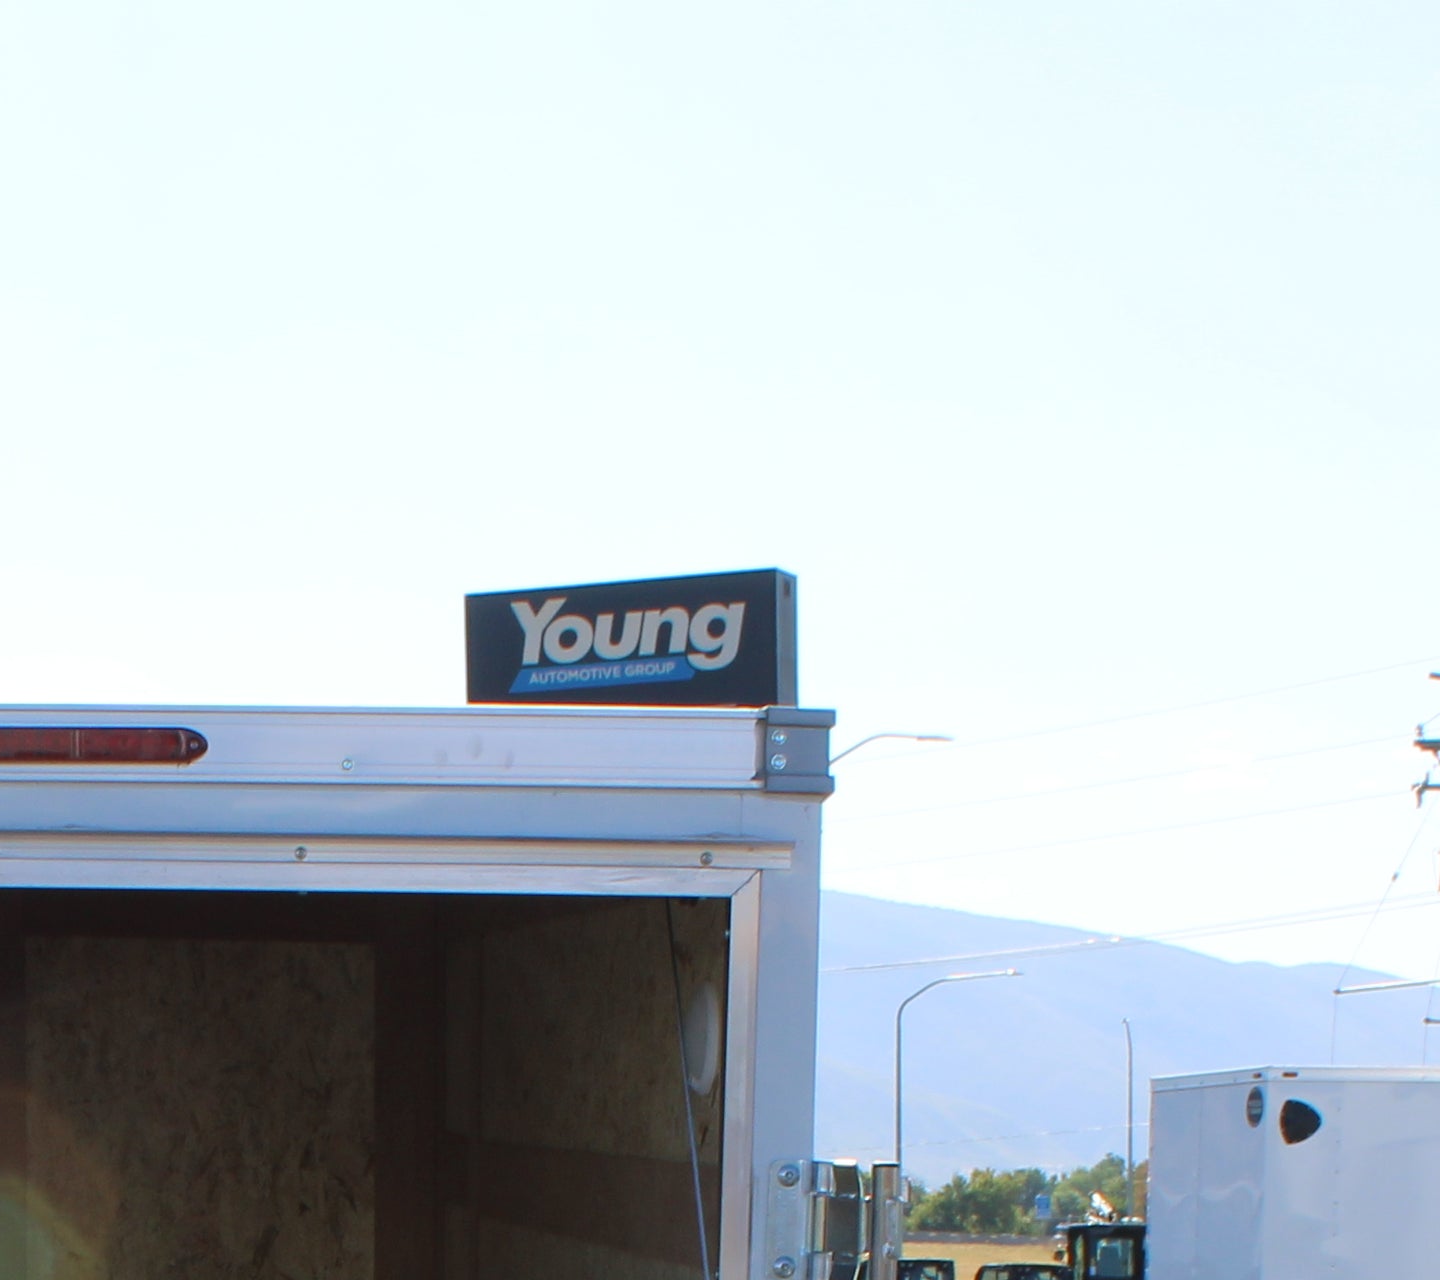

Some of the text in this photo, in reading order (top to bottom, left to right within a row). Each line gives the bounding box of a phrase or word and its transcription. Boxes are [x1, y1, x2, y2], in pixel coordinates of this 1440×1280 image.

[510, 597, 746, 671] Young
[529, 661, 676, 685] AUTOMOTIVE GROUP
